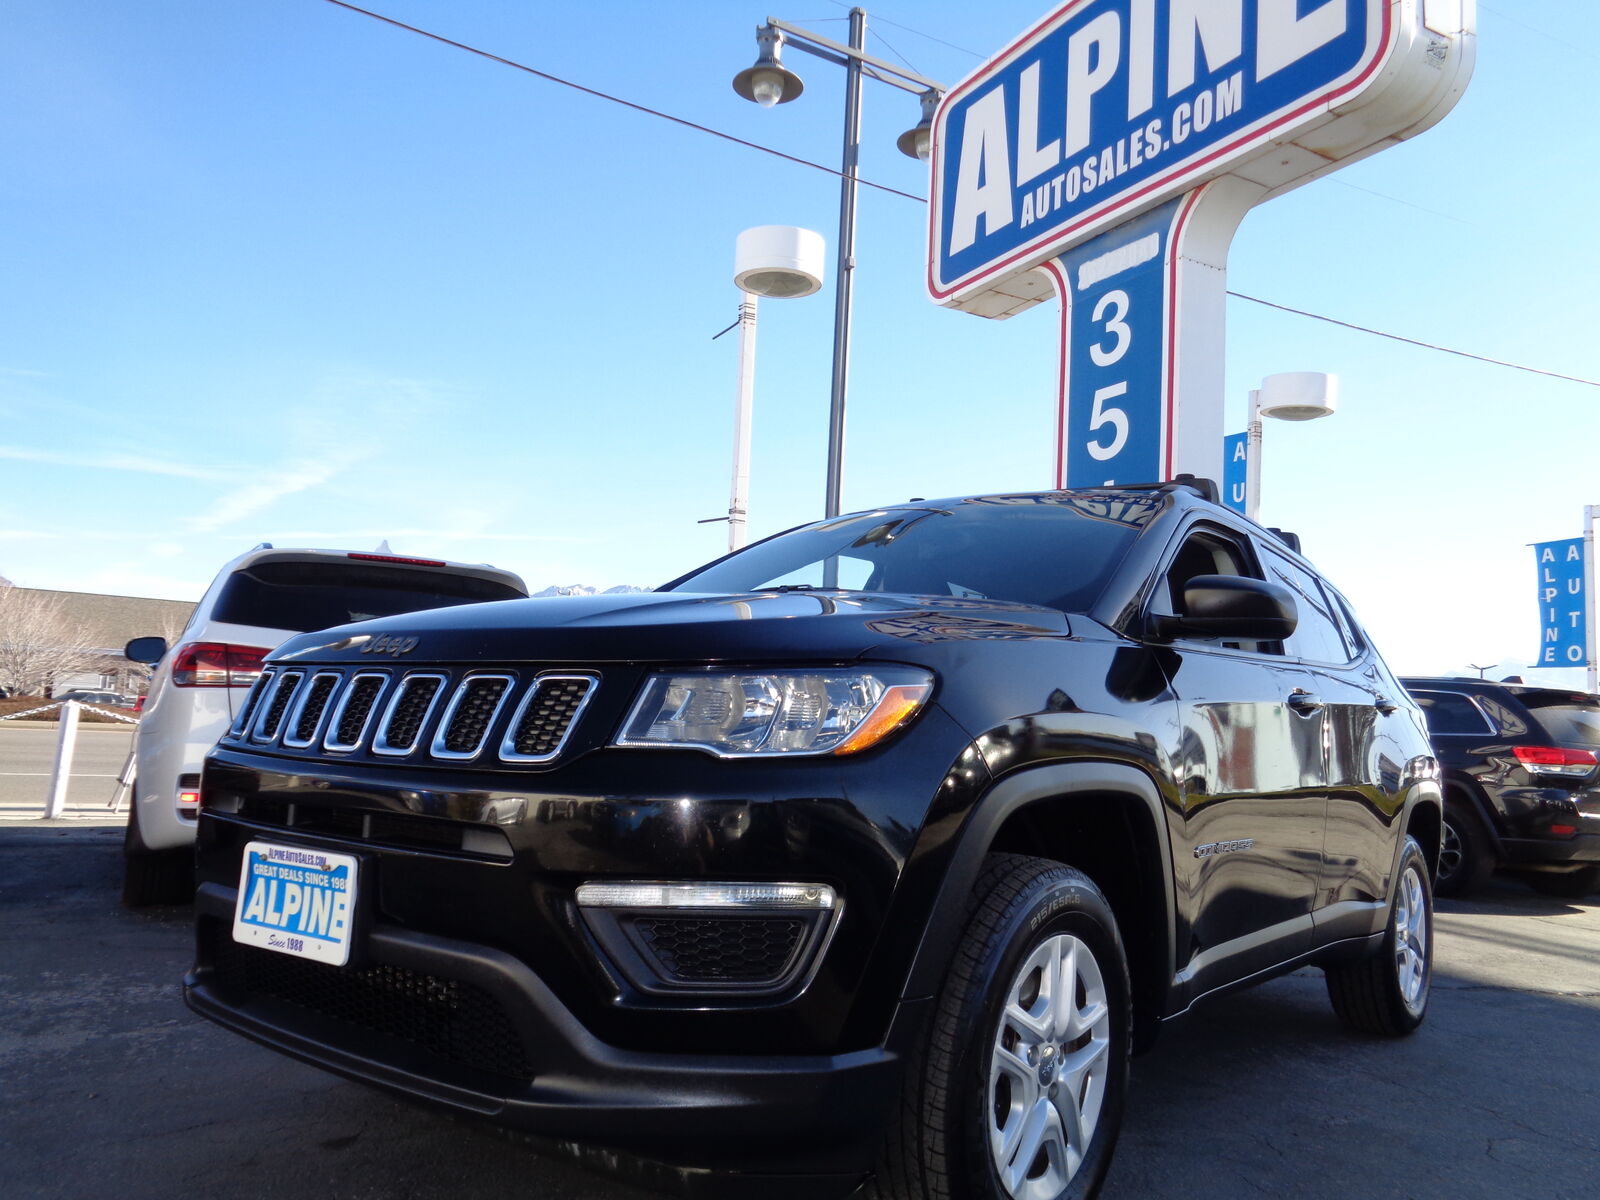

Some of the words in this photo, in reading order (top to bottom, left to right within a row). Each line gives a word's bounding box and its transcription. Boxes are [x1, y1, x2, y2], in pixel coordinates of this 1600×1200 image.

[1020, 71, 1243, 229] AUTOSALES.COM
[1086, 289, 1132, 486] 35
[360, 633, 420, 657] Jeep
[1541, 547, 1559, 662] ALPINE
[1566, 545, 1583, 662] AUTO
[243, 877, 348, 939] ALPINE
[253, 863, 278, 878] GREAT
[278, 867, 304, 883] DEALS
[305, 872, 329, 887] SINCE
[331, 877, 347, 890] 198
[267, 934, 286, 948] Since
[287, 937, 304, 952] 1988
